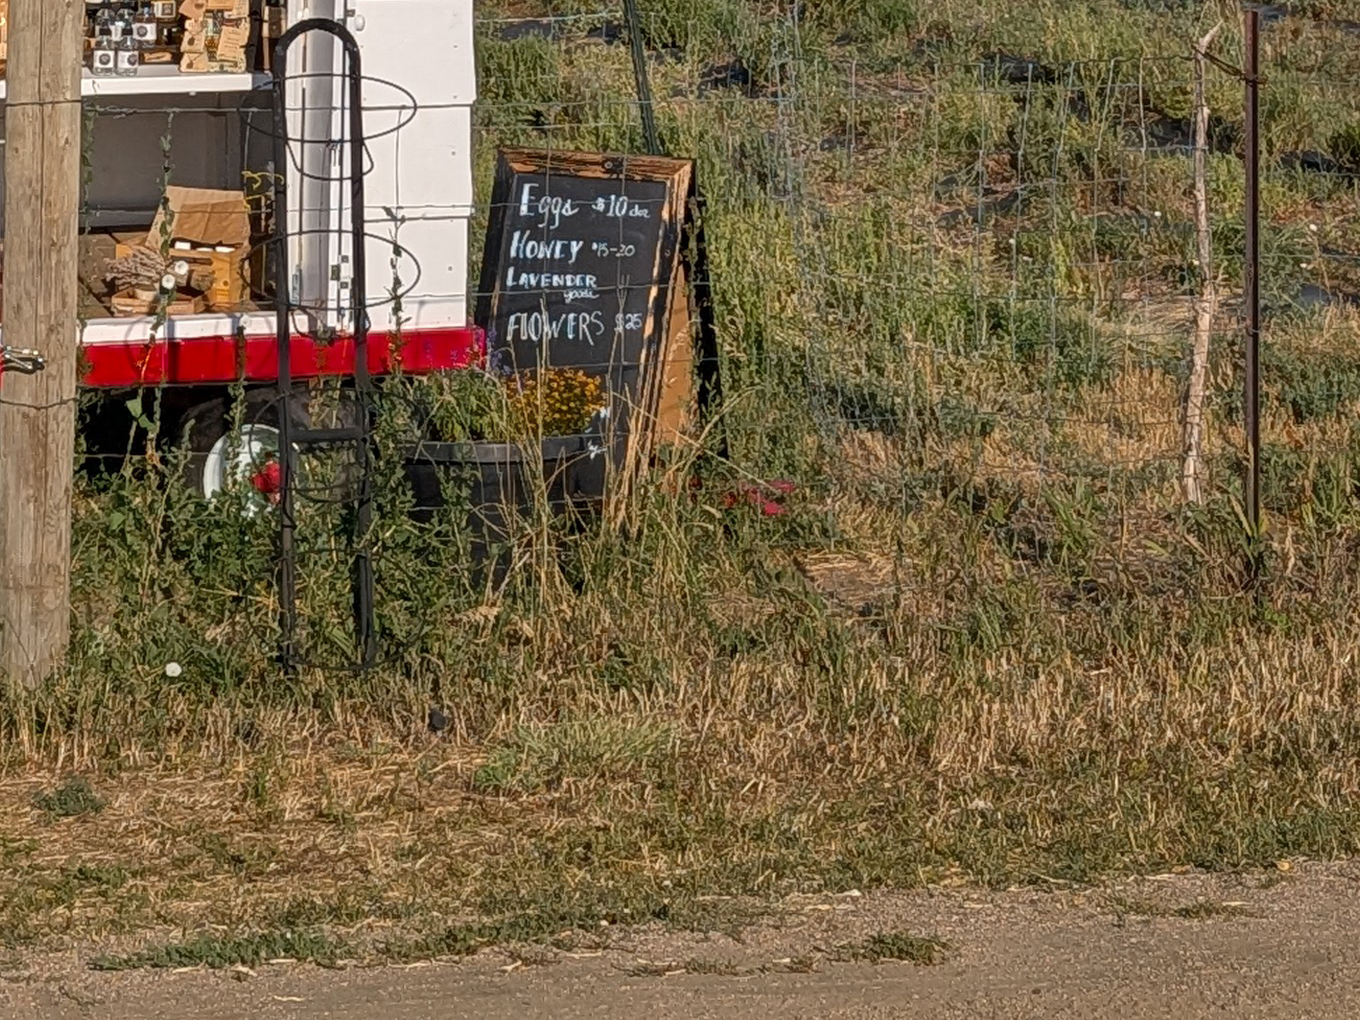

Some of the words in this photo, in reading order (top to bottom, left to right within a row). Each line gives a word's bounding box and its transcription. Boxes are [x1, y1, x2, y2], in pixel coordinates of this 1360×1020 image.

[519, 183, 580, 229] Eggs
[591, 194, 628, 218] $10
[509, 230, 584, 264] HONEY
[505, 266, 598, 289] LAVENDER
